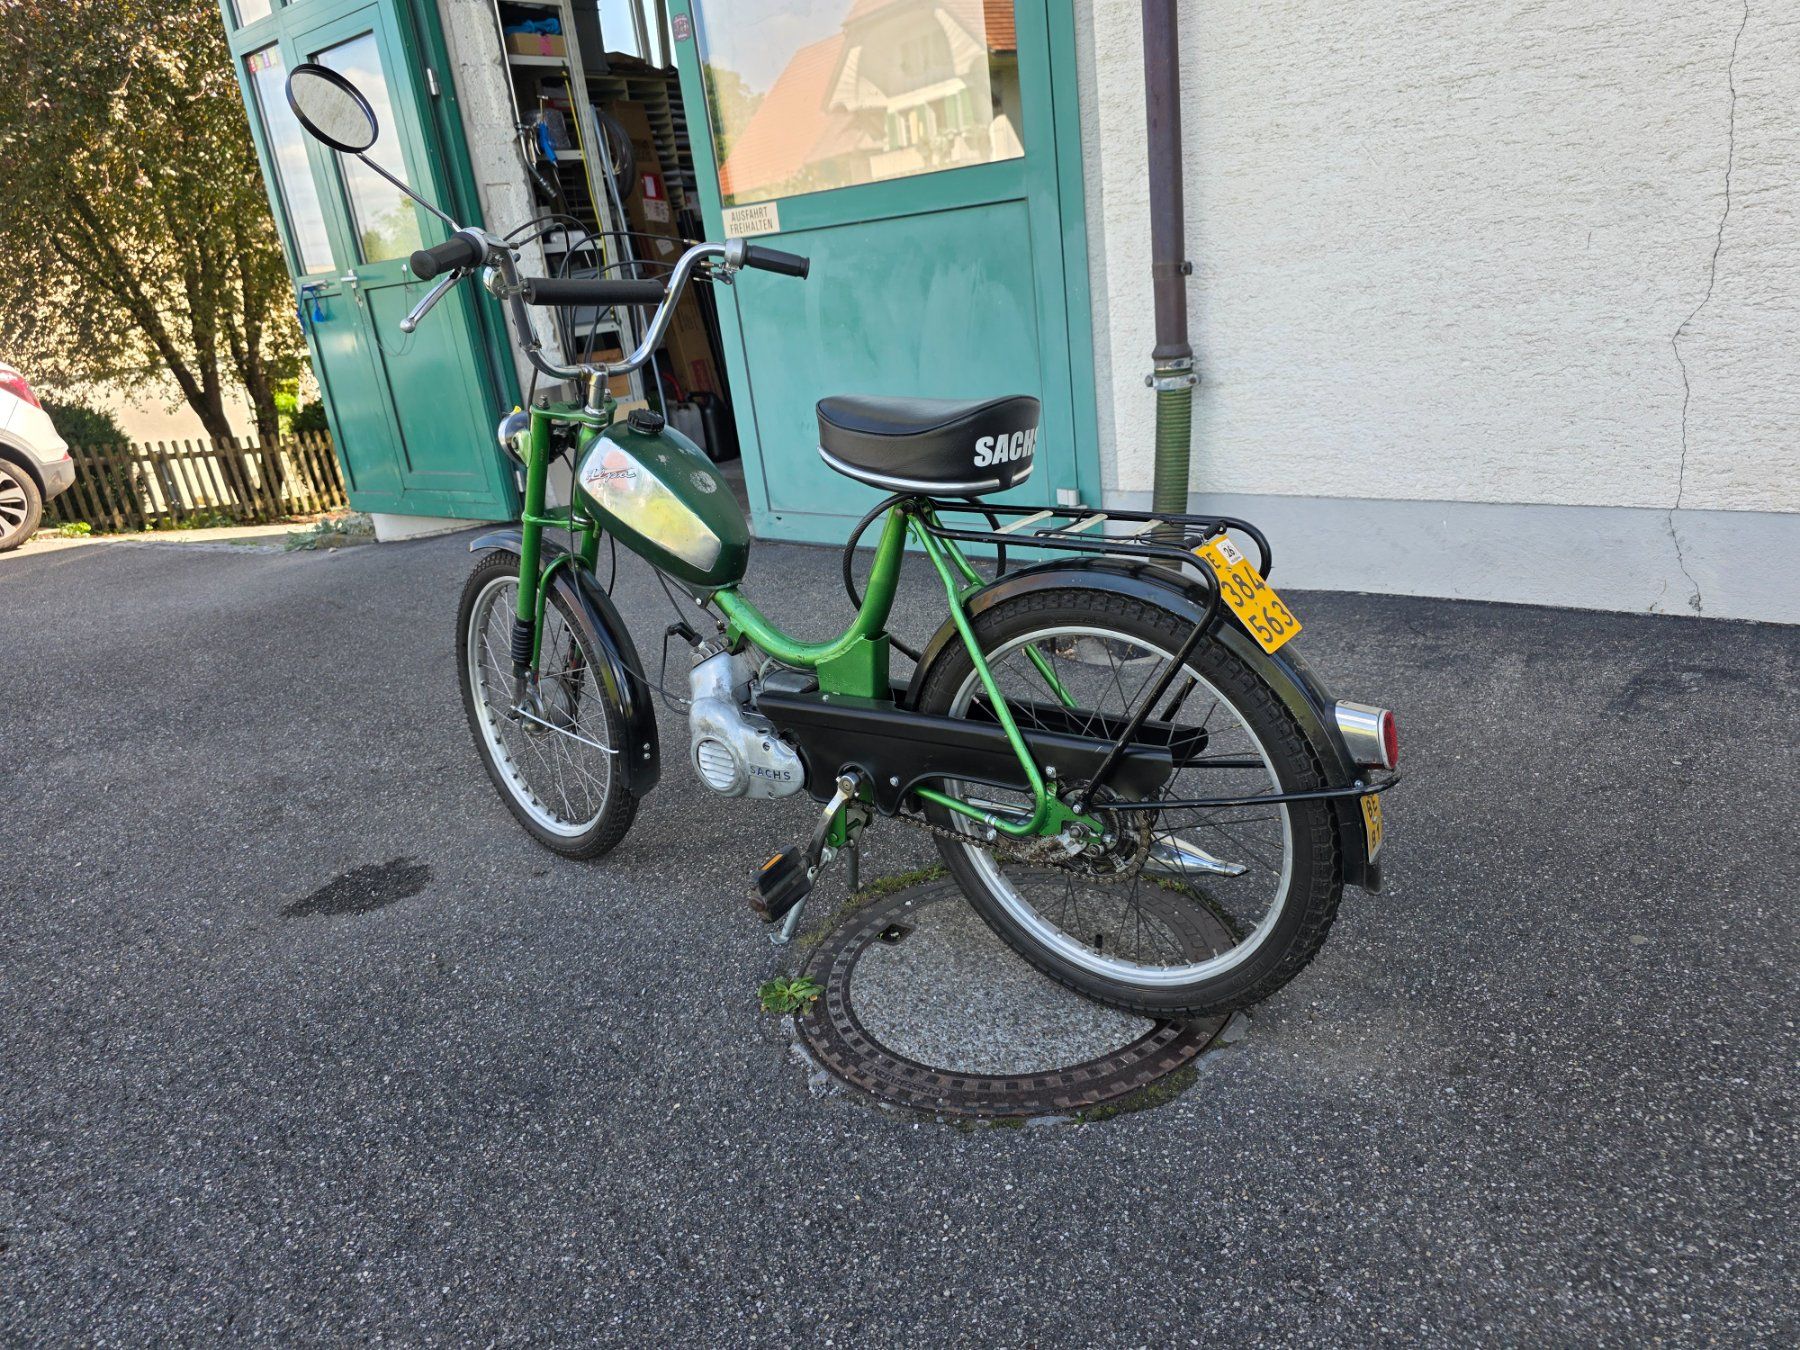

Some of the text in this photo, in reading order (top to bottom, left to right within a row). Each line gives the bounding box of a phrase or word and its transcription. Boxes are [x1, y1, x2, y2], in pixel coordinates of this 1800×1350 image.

[731, 207, 767, 222] AUSFAHRT
[730, 218, 773, 234] FREIHALTEN
[1223, 545, 1236, 558] 26
[1221, 566, 1266, 607] 384
[1248, 601, 1294, 643] 563
[750, 765, 791, 780] SACHS
